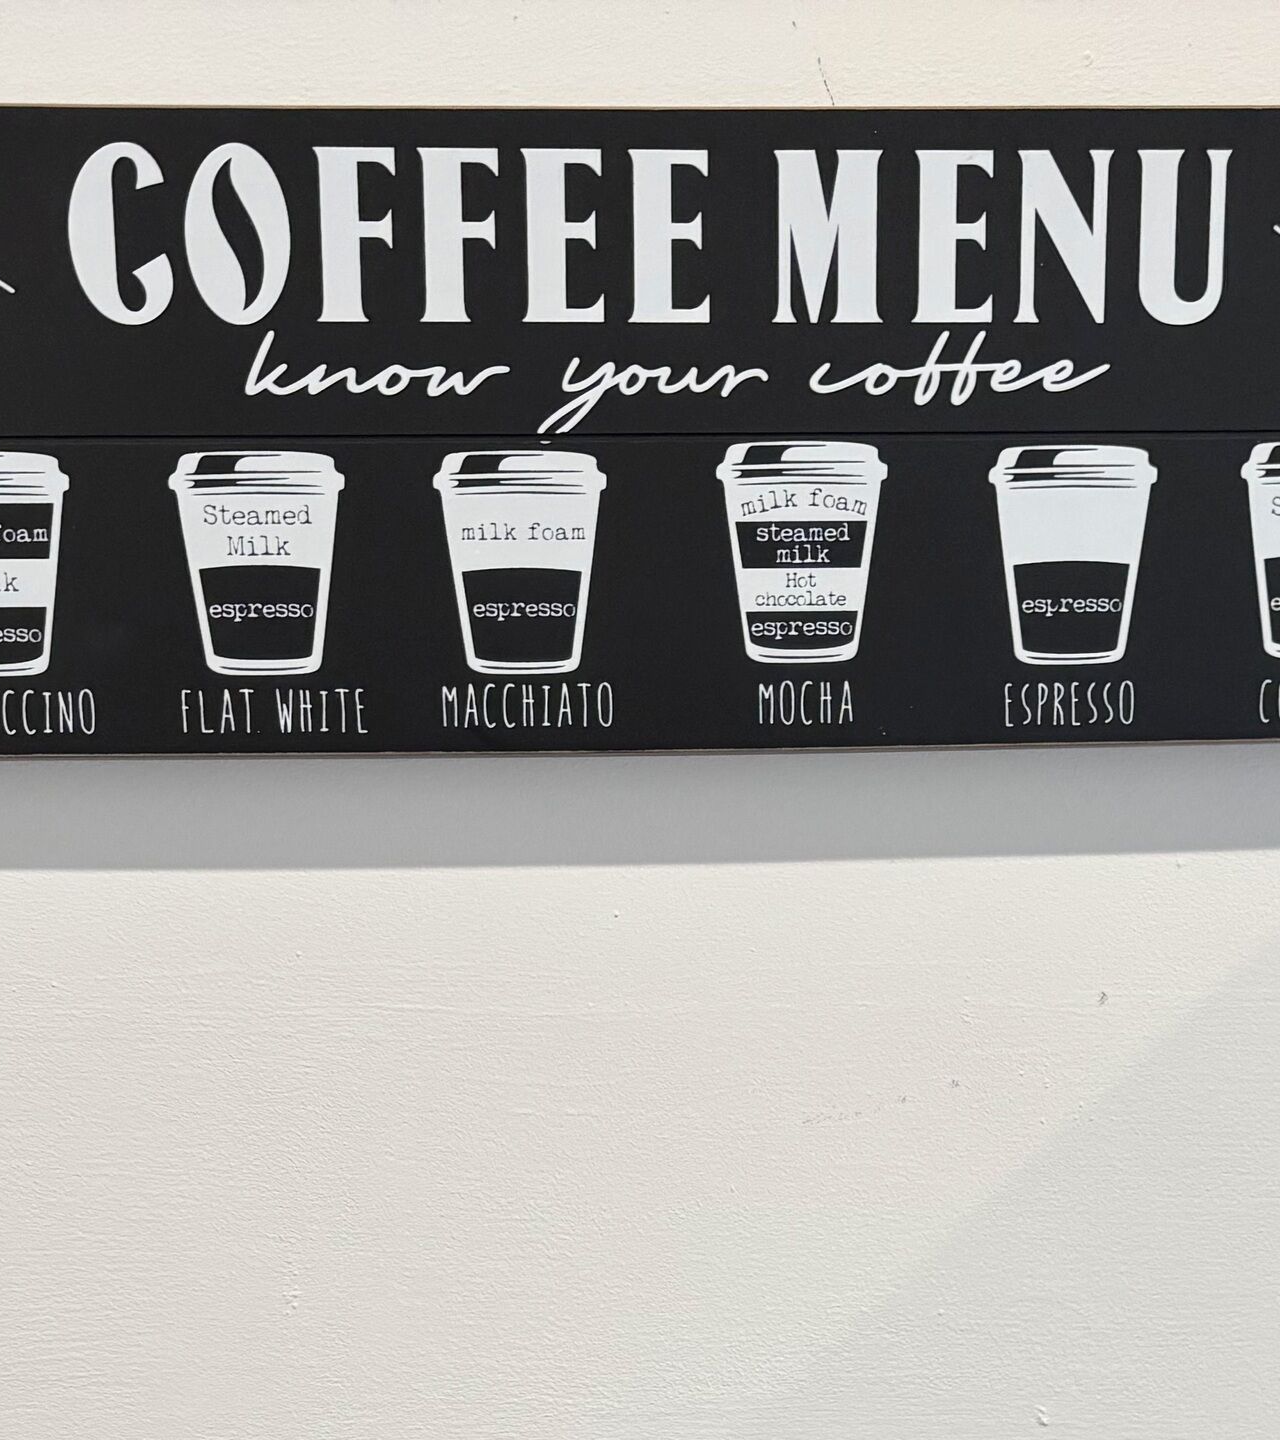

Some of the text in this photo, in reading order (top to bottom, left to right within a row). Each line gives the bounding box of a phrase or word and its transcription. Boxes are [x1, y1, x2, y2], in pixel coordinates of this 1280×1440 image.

[68, 142, 1233, 326] COFFEE MENU
[244, 330, 1111, 434] know your coffee
[740, 488, 867, 518] milk foam
[202, 504, 313, 526] Steamed
[461, 522, 586, 542] milk foam
[756, 523, 850, 543] steamed
[226, 535, 291, 557] Milk
[776, 545, 830, 564] milk
[786, 572, 817, 588] Hot
[755, 590, 847, 607] chocolate
[1021, 596, 1122, 617] espresso
[209, 602, 314, 622] espresso
[472, 601, 576, 622] espresso
[751, 619, 853, 640] espresso
[275, 687, 369, 735] WHITE
[441, 681, 614, 729] MACCHIATO
[758, 680, 855, 726] MOCHA
[1004, 680, 1135, 728] ESPRESSO
